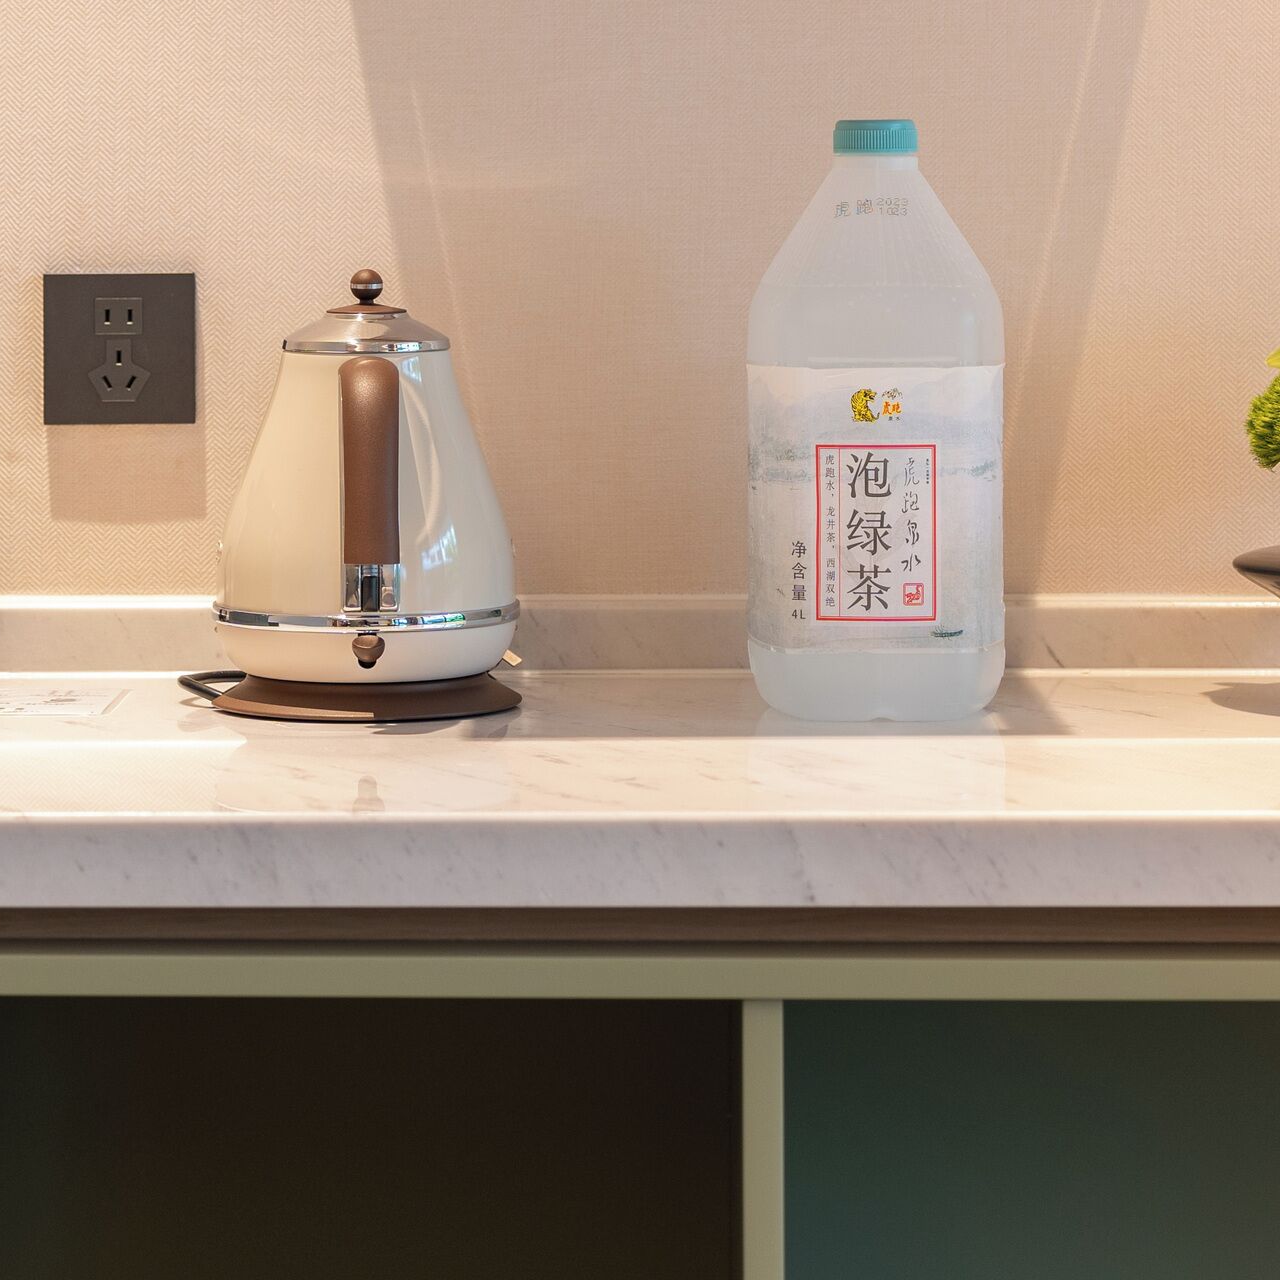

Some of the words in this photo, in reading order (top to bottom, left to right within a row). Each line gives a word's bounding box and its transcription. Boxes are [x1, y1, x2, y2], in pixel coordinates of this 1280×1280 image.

[846, 451, 892, 612] 泡绿茶
[791, 540, 807, 601] 净含量
[791, 609, 807, 620] 4L
